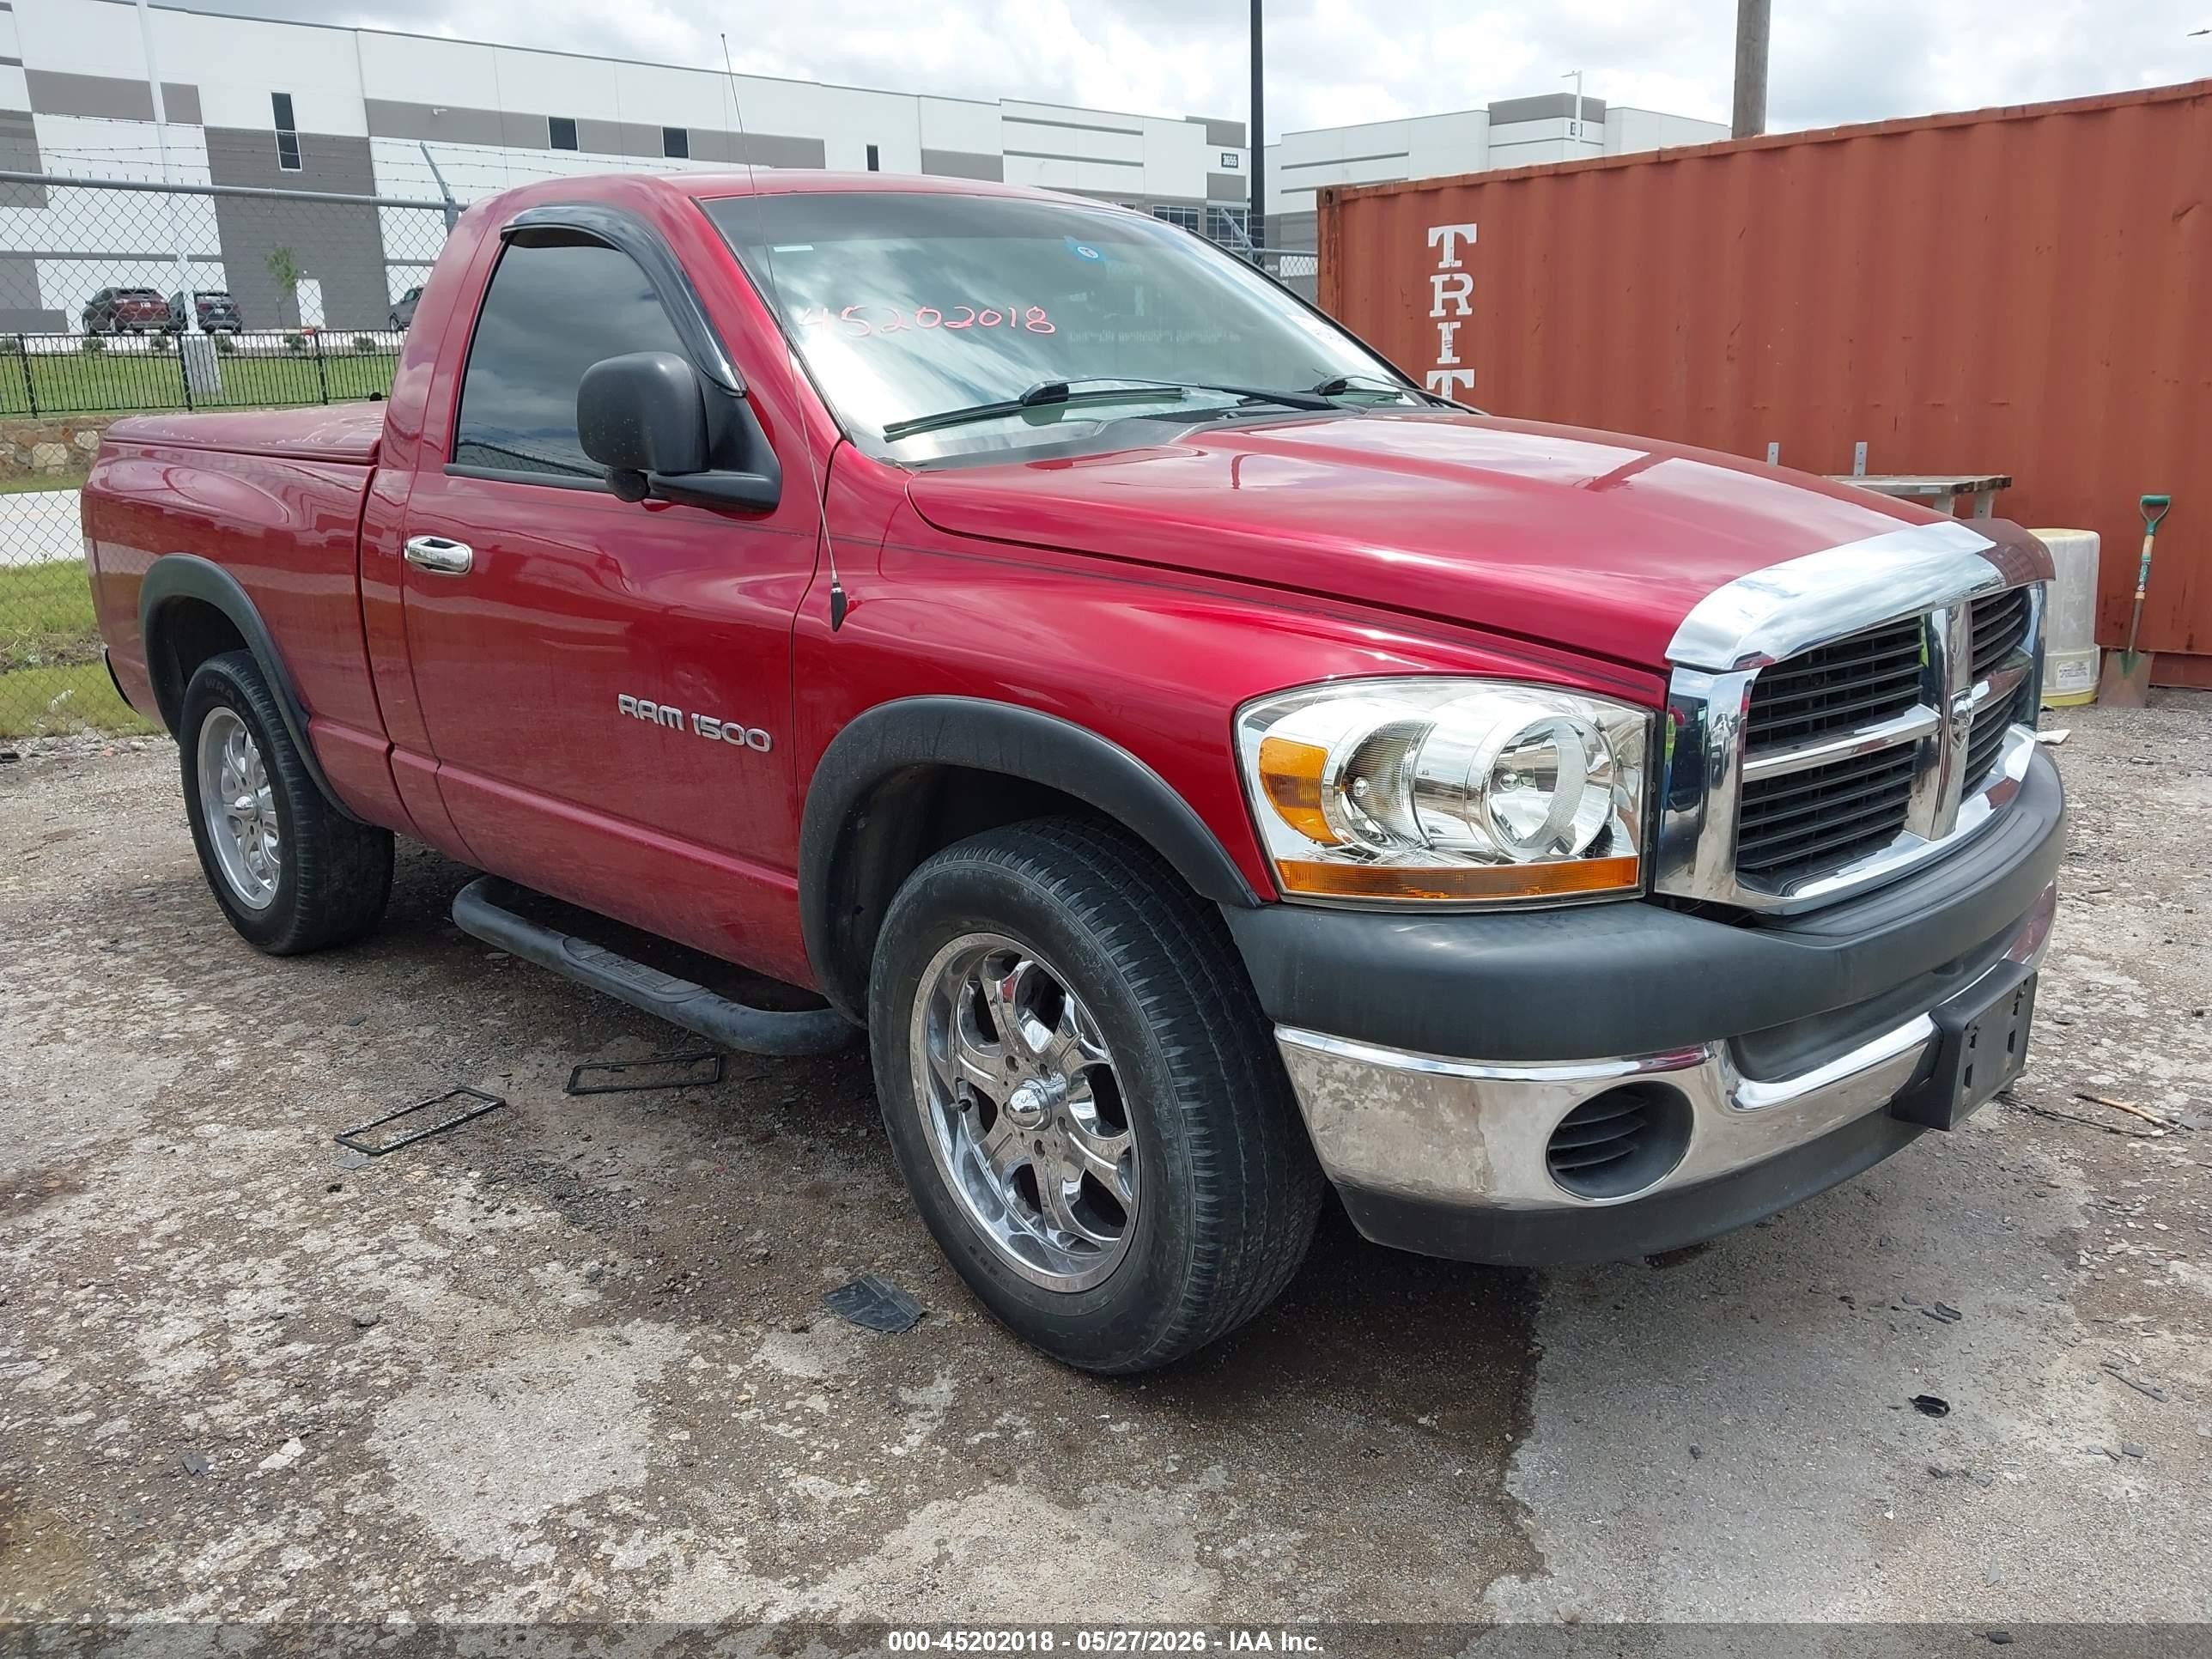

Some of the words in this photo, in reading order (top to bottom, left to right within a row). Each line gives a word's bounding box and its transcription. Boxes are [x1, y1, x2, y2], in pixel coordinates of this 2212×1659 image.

[797, 306, 1056, 337] 45202018
[1427, 223, 1477, 400] TRIT
[618, 693, 685, 731] RAM
[691, 713, 773, 752] 1500
